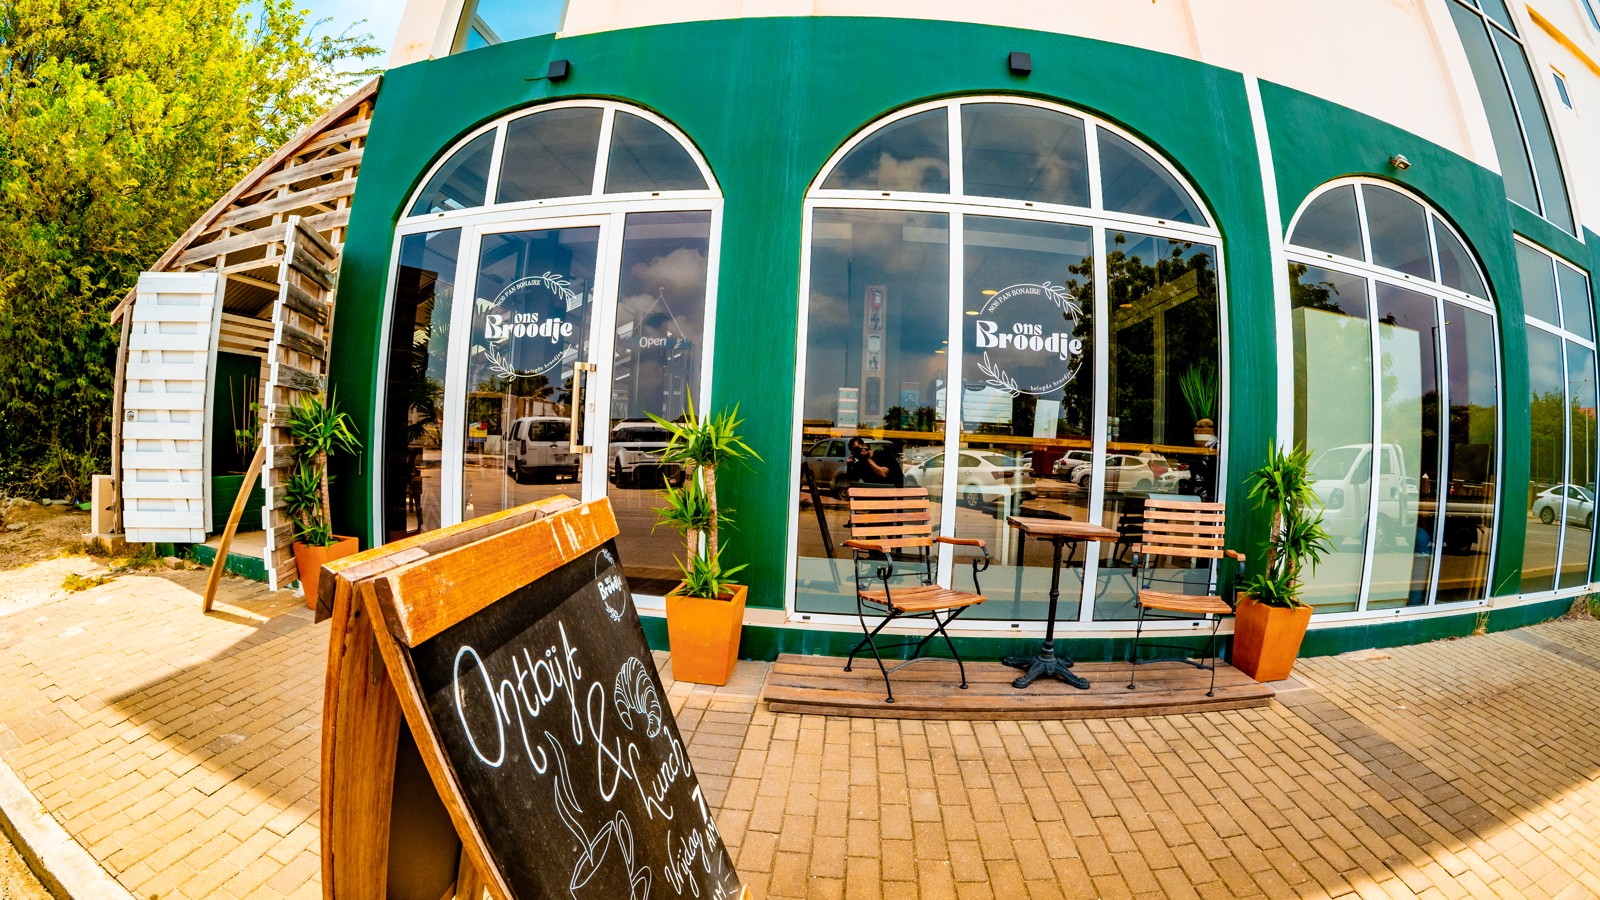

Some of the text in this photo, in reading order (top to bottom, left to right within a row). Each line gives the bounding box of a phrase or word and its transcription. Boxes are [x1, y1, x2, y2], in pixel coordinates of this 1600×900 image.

[505, 286, 517, 297] PAN
[516, 280, 541, 290] BONAIRE
[988, 287, 1041, 313] NOS PAN BONAIRE
[484, 314, 573, 345] Broodje
[514, 312, 539, 324] ons
[1013, 322, 1043, 335] ons
[639, 336, 667, 349] Open
[976, 320, 1083, 361] Broodje
[586, 681, 691, 820] & Lunch
[692, 784, 720, 853] 7 AM
